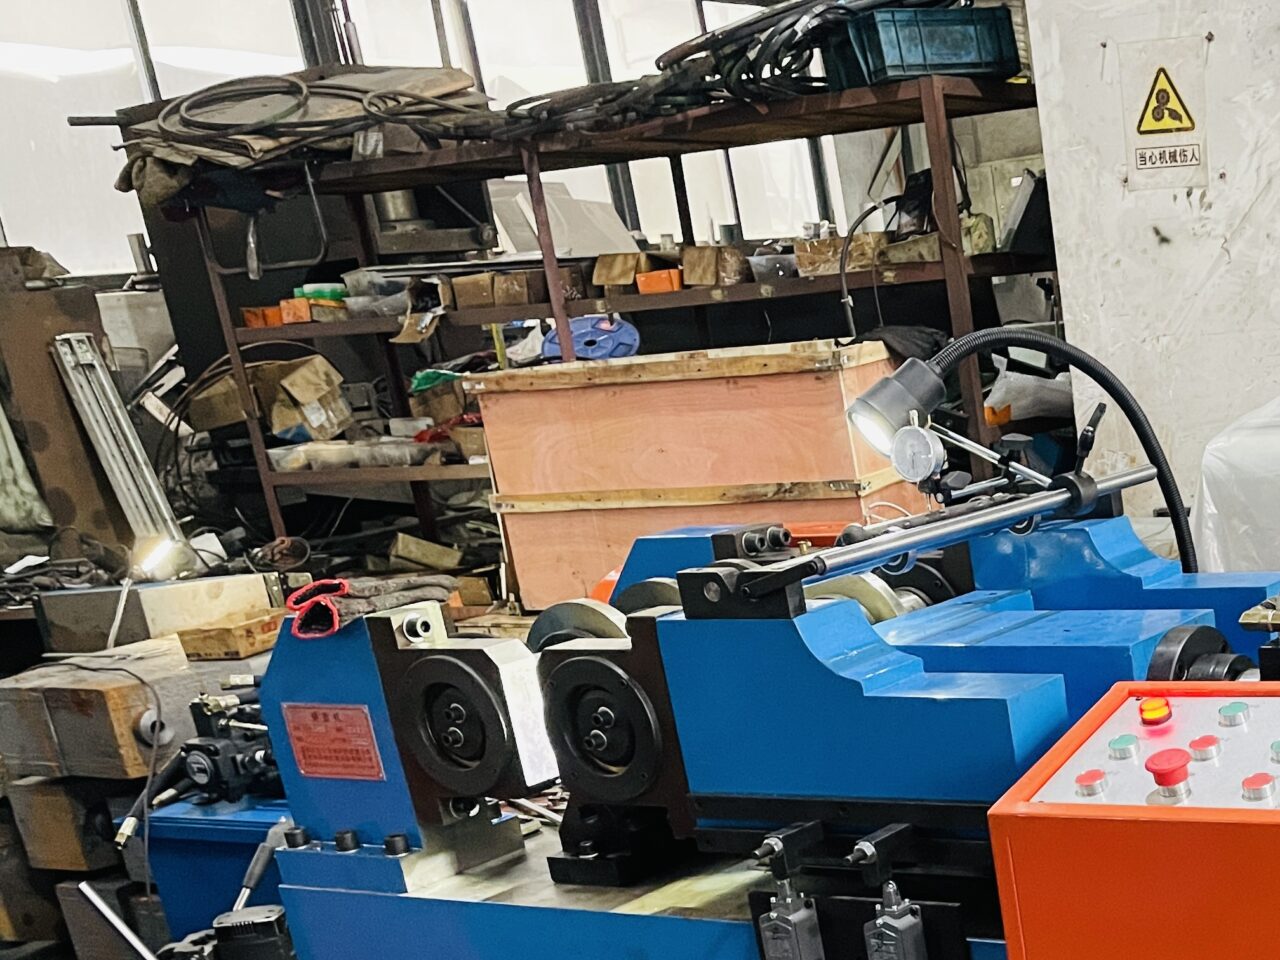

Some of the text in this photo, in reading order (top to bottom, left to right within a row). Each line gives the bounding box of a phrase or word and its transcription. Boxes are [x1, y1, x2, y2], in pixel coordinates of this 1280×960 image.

[1138, 147, 1199, 166] 当心机械伤人
